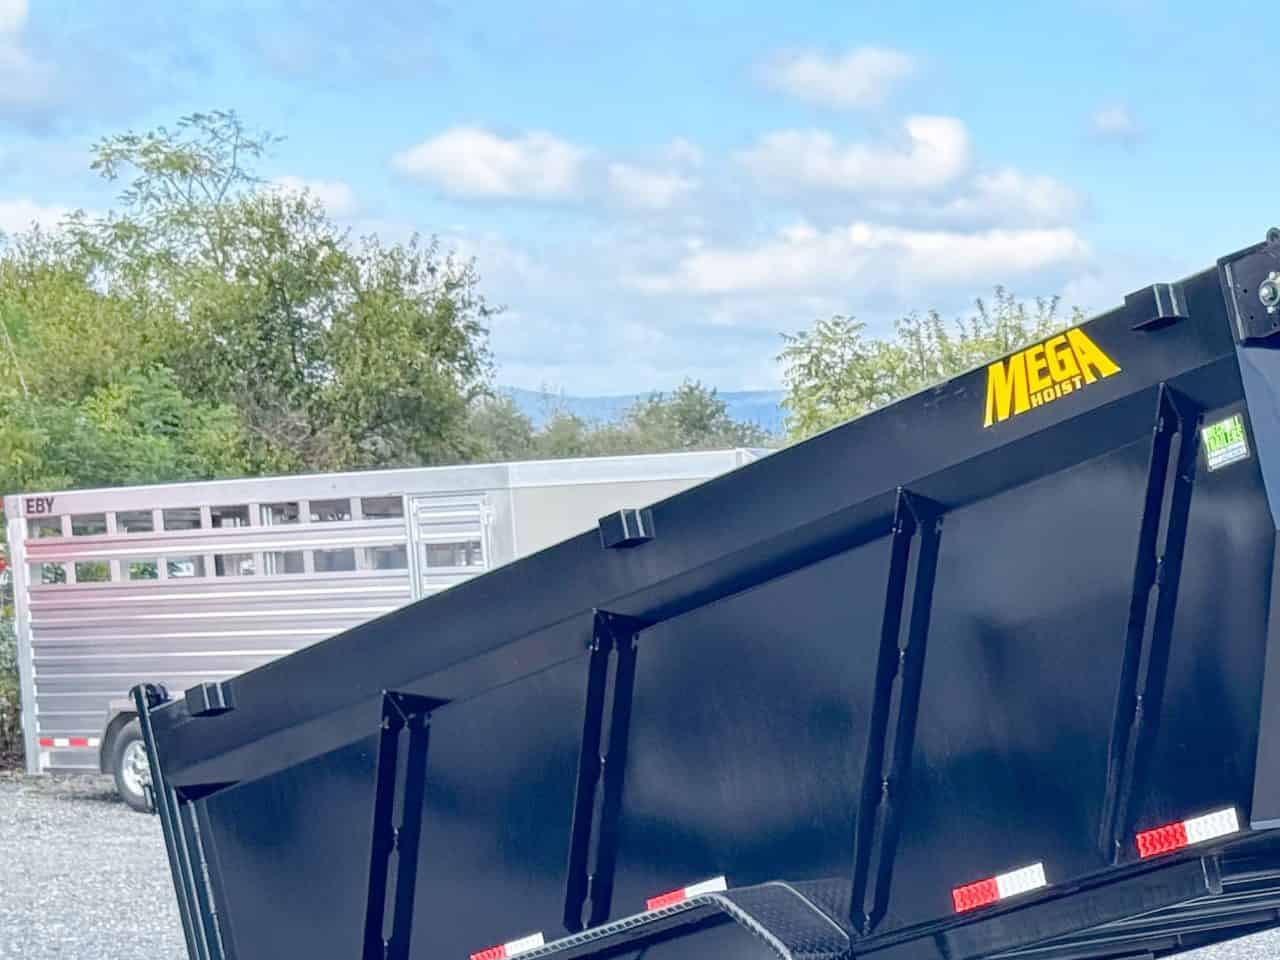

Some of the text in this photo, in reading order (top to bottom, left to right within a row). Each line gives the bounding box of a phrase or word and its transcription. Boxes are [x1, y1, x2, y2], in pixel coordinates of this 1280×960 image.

[984, 327, 1121, 428] MEGA
[1029, 376, 1082, 408] HOIST
[26, 496, 55, 513] EBY
